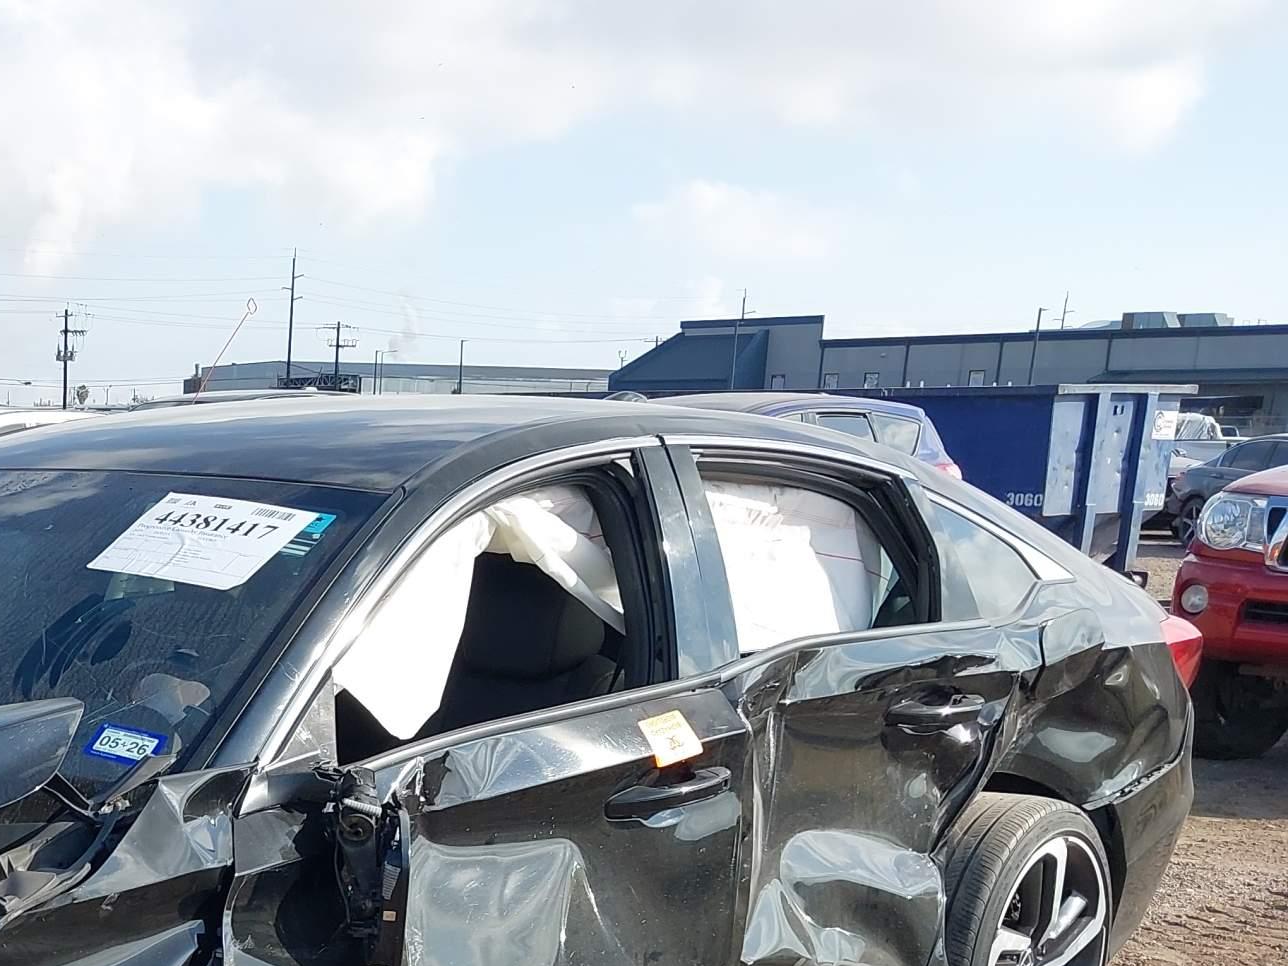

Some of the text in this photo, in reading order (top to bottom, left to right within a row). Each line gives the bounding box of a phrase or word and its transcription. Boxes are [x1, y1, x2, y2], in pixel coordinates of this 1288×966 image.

[1006, 492, 1044, 507] 3060
[1144, 492, 1164, 507] 3060
[154, 510, 280, 541] 44381417
